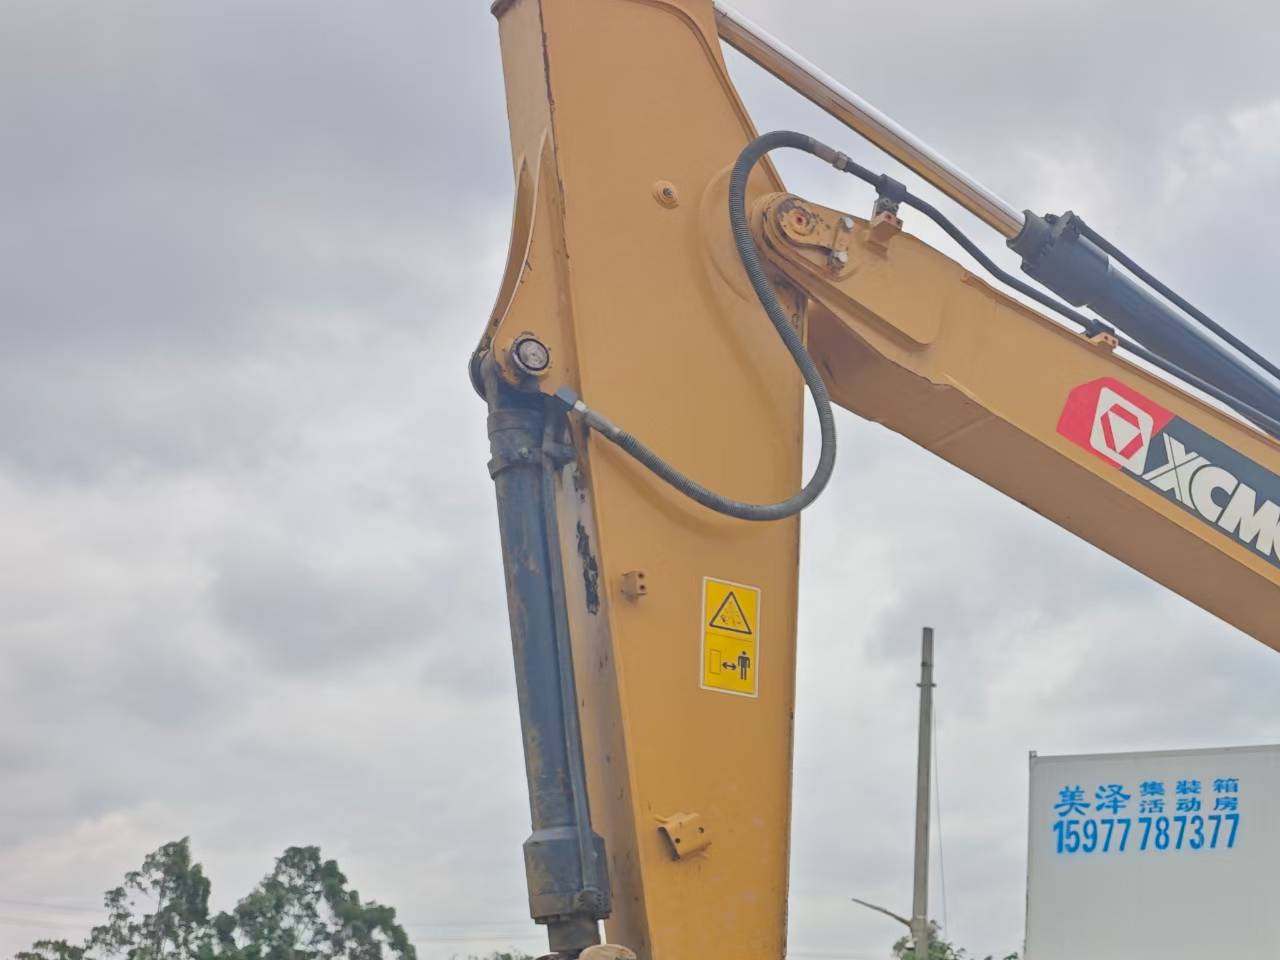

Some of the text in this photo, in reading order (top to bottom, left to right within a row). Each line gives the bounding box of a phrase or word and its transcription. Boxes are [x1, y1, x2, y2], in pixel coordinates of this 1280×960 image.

[1139, 777, 1239, 796] 集装箱
[1053, 784, 1131, 817] 美泽
[1139, 796, 1238, 813] 活动房
[1053, 813, 1240, 854] 15977787377
